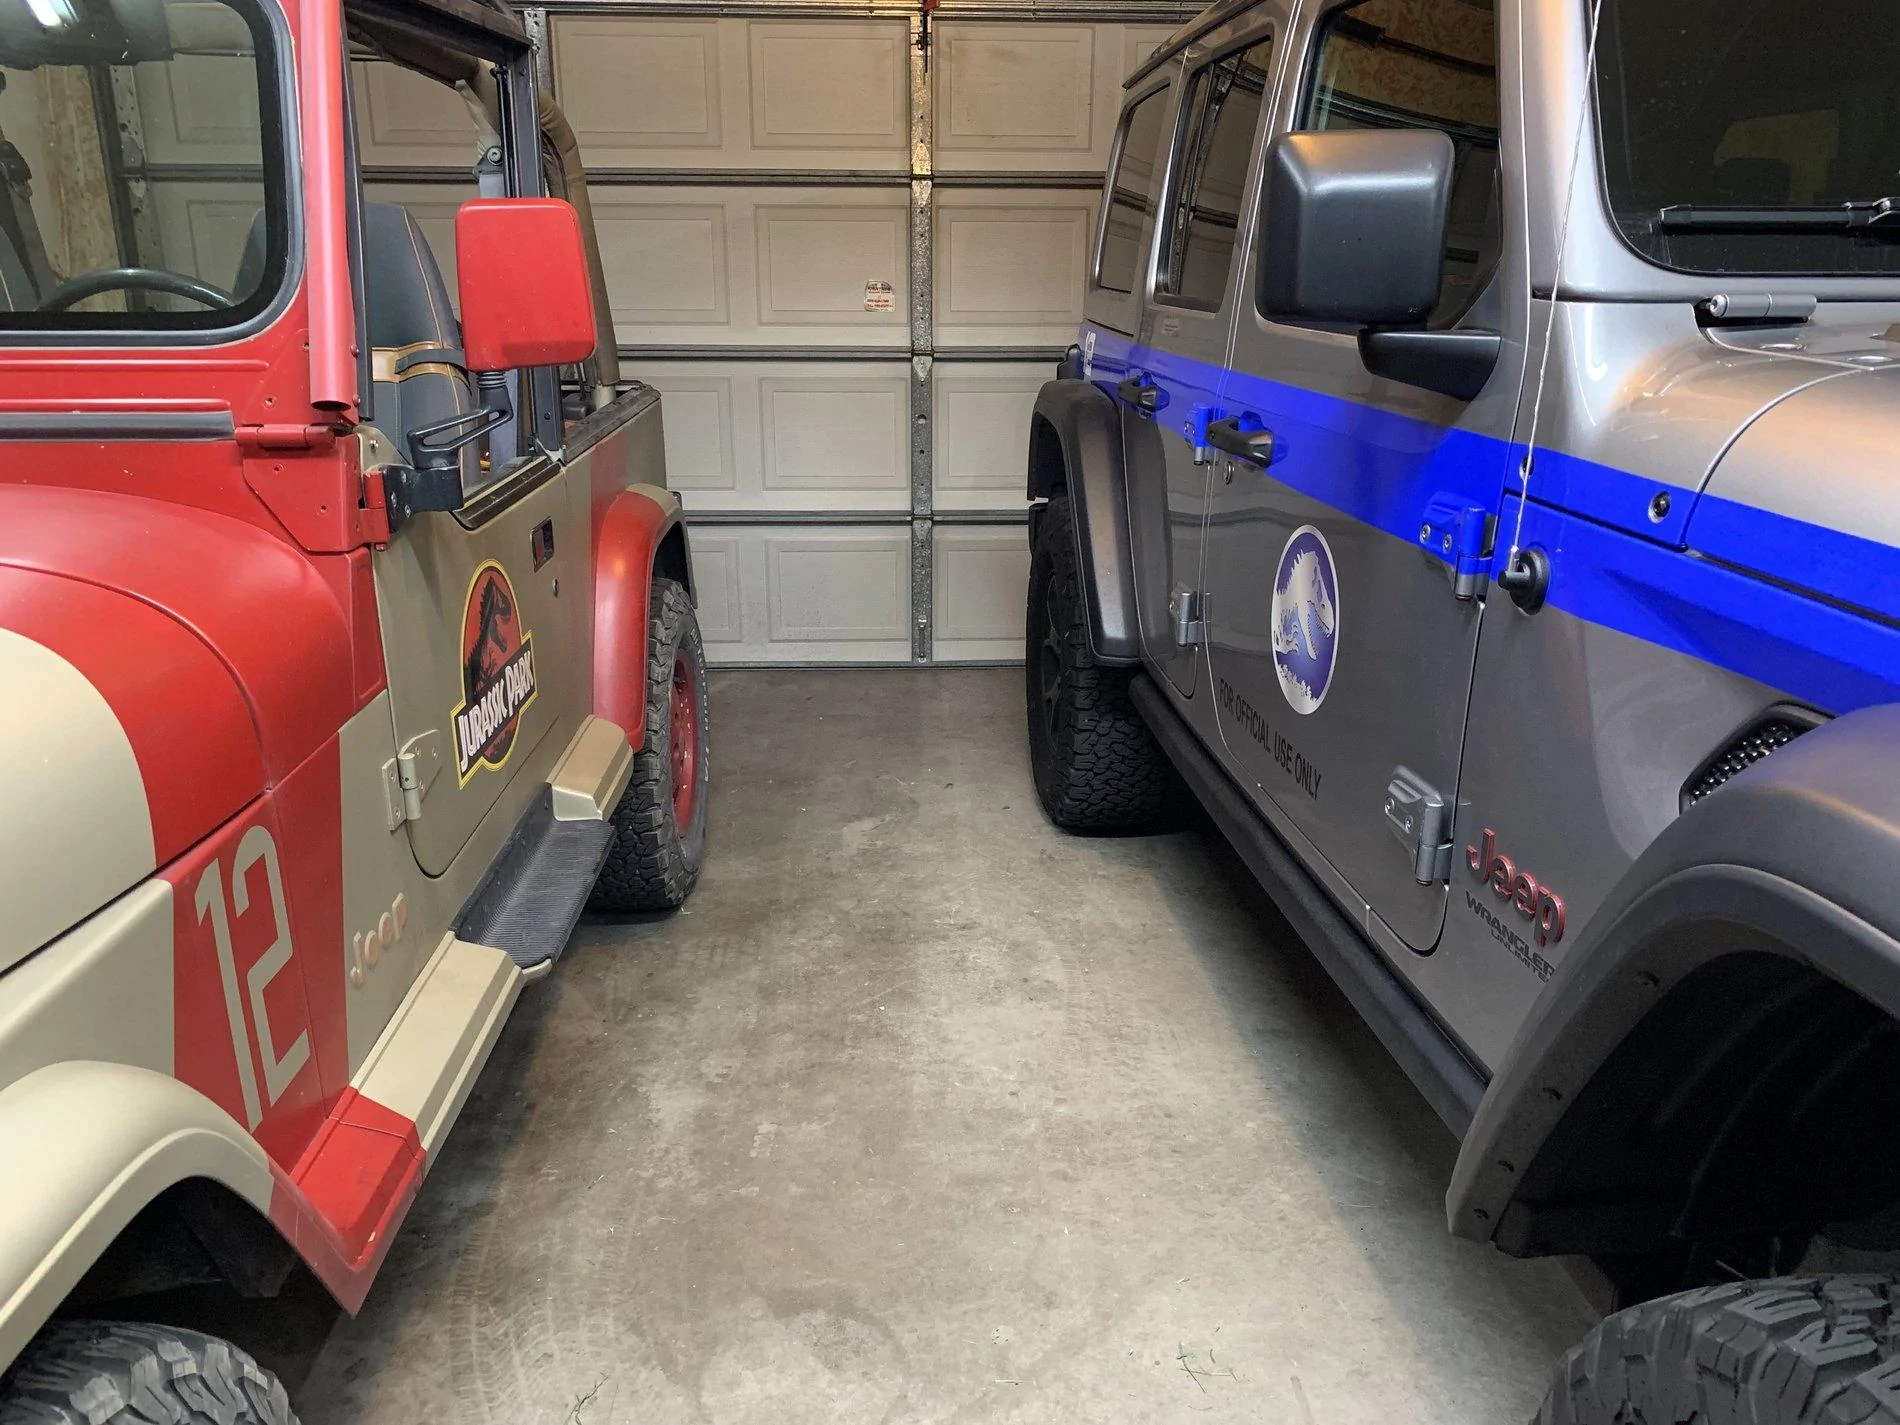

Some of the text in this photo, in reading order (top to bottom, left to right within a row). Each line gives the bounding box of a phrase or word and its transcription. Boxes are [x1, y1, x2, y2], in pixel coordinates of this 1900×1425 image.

[457, 649, 535, 773] JURASSIC PARK
[1220, 677, 1322, 801] FOR OFFICIAL USE ONLY
[350, 891, 408, 990] Jeep
[1466, 827, 1568, 949] Jeep
[194, 825, 311, 1135] 12
[1490, 927, 1549, 984] UNLIMITE
